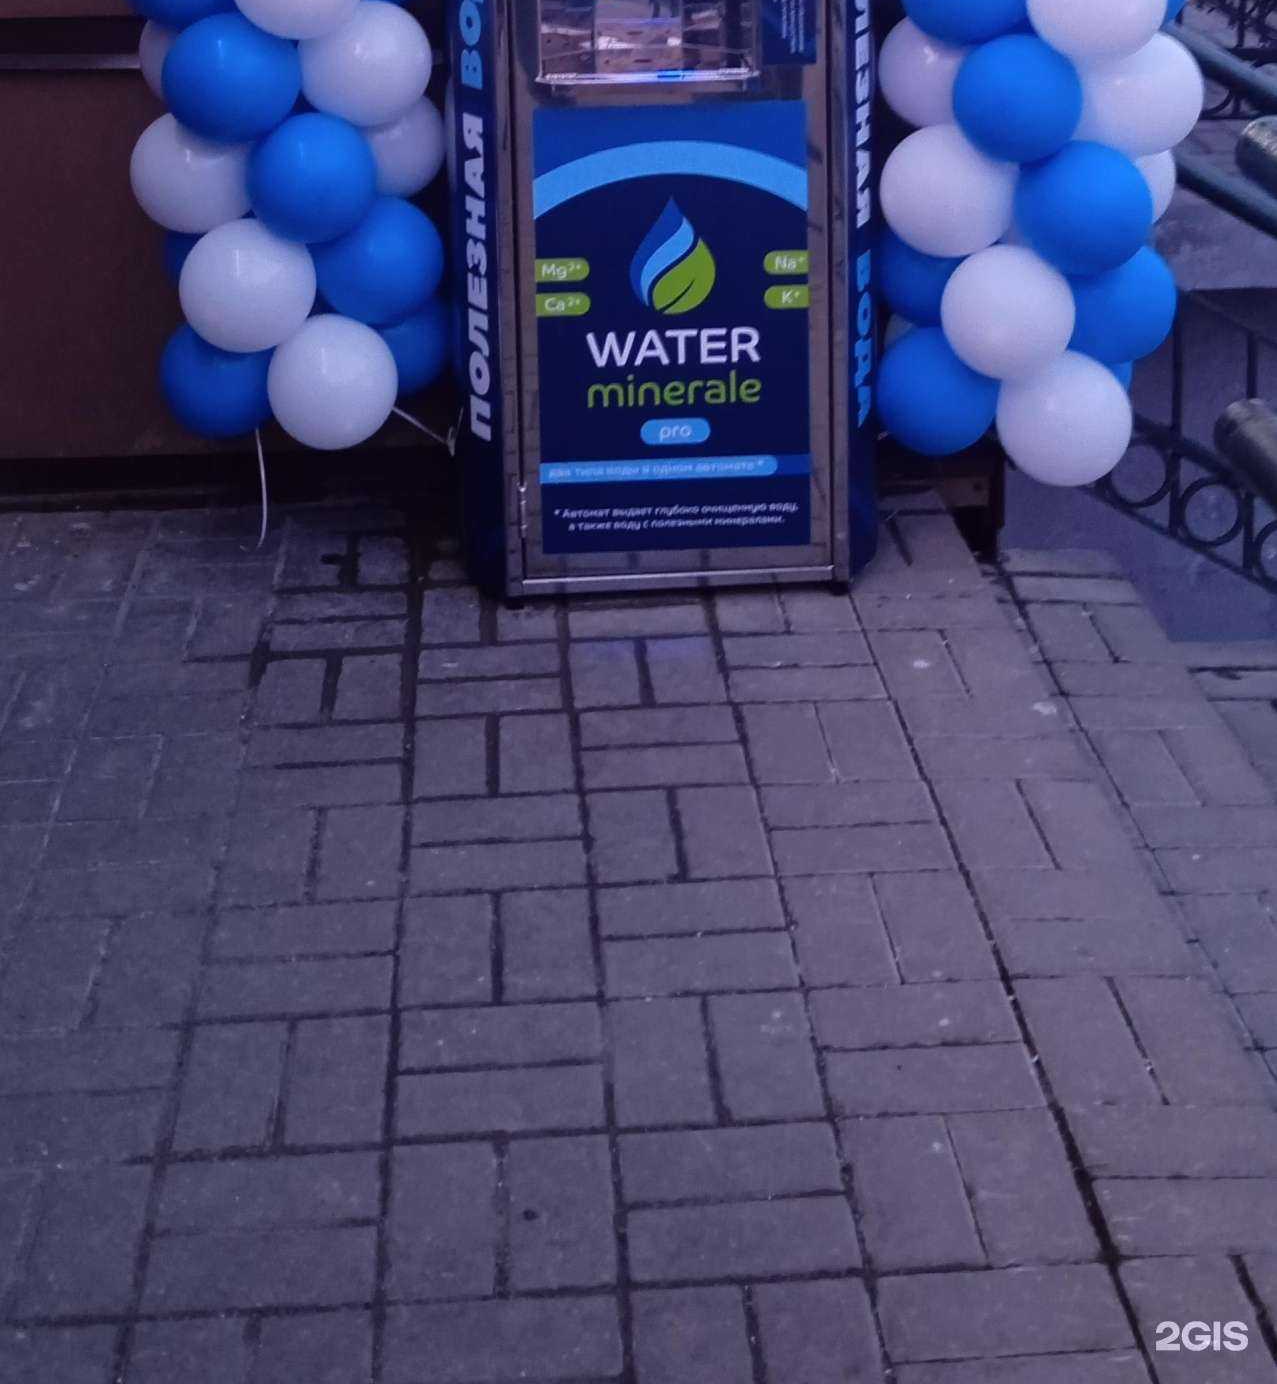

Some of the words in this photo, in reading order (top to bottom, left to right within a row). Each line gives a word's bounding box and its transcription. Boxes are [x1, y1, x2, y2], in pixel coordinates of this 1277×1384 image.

[463, 113, 491, 442] ПОЛЕЗНАЯ
[585, 326, 761, 368] WATER
[854, 248, 872, 428] ВОДА
[586, 369, 762, 409] minerale
[659, 426, 691, 442] pro
[613, 519, 641, 531] воду
[651, 517, 713, 529] полезными
[654, 504, 700, 517] глубоко
[701, 503, 767, 514] очищенную
